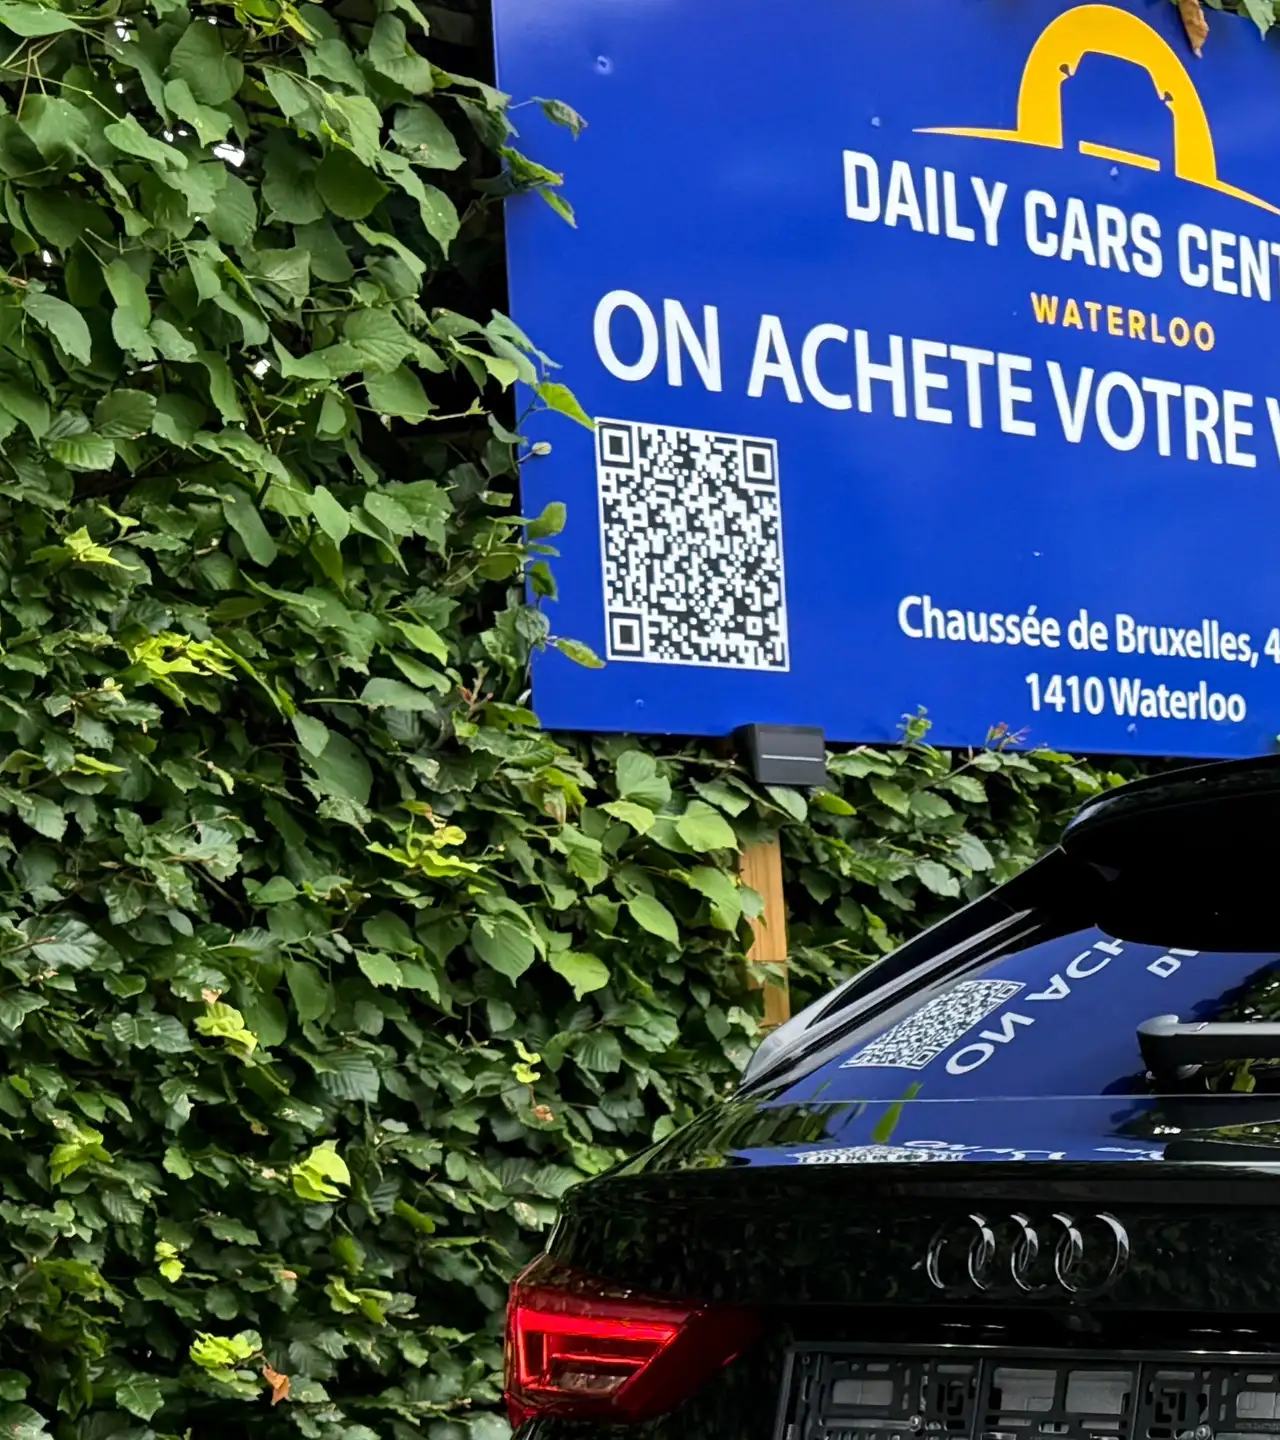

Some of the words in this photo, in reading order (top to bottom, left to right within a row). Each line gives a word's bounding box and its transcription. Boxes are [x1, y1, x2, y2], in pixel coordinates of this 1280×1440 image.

[842, 149, 1008, 247] DAILY
[1024, 189, 1163, 279] CARS
[1030, 291, 1216, 352] WATERLOO
[593, 289, 722, 392] ON
[747, 314, 1037, 437] ACHETE
[1047, 360, 1257, 468] VOTRE
[898, 595, 1062, 649] Chaussée
[1067, 608, 1109, 652] de
[1115, 613, 1259, 668] Bruxelles,
[1025, 672, 1105, 715] 1410
[1108, 676, 1246, 723] Waterloo
